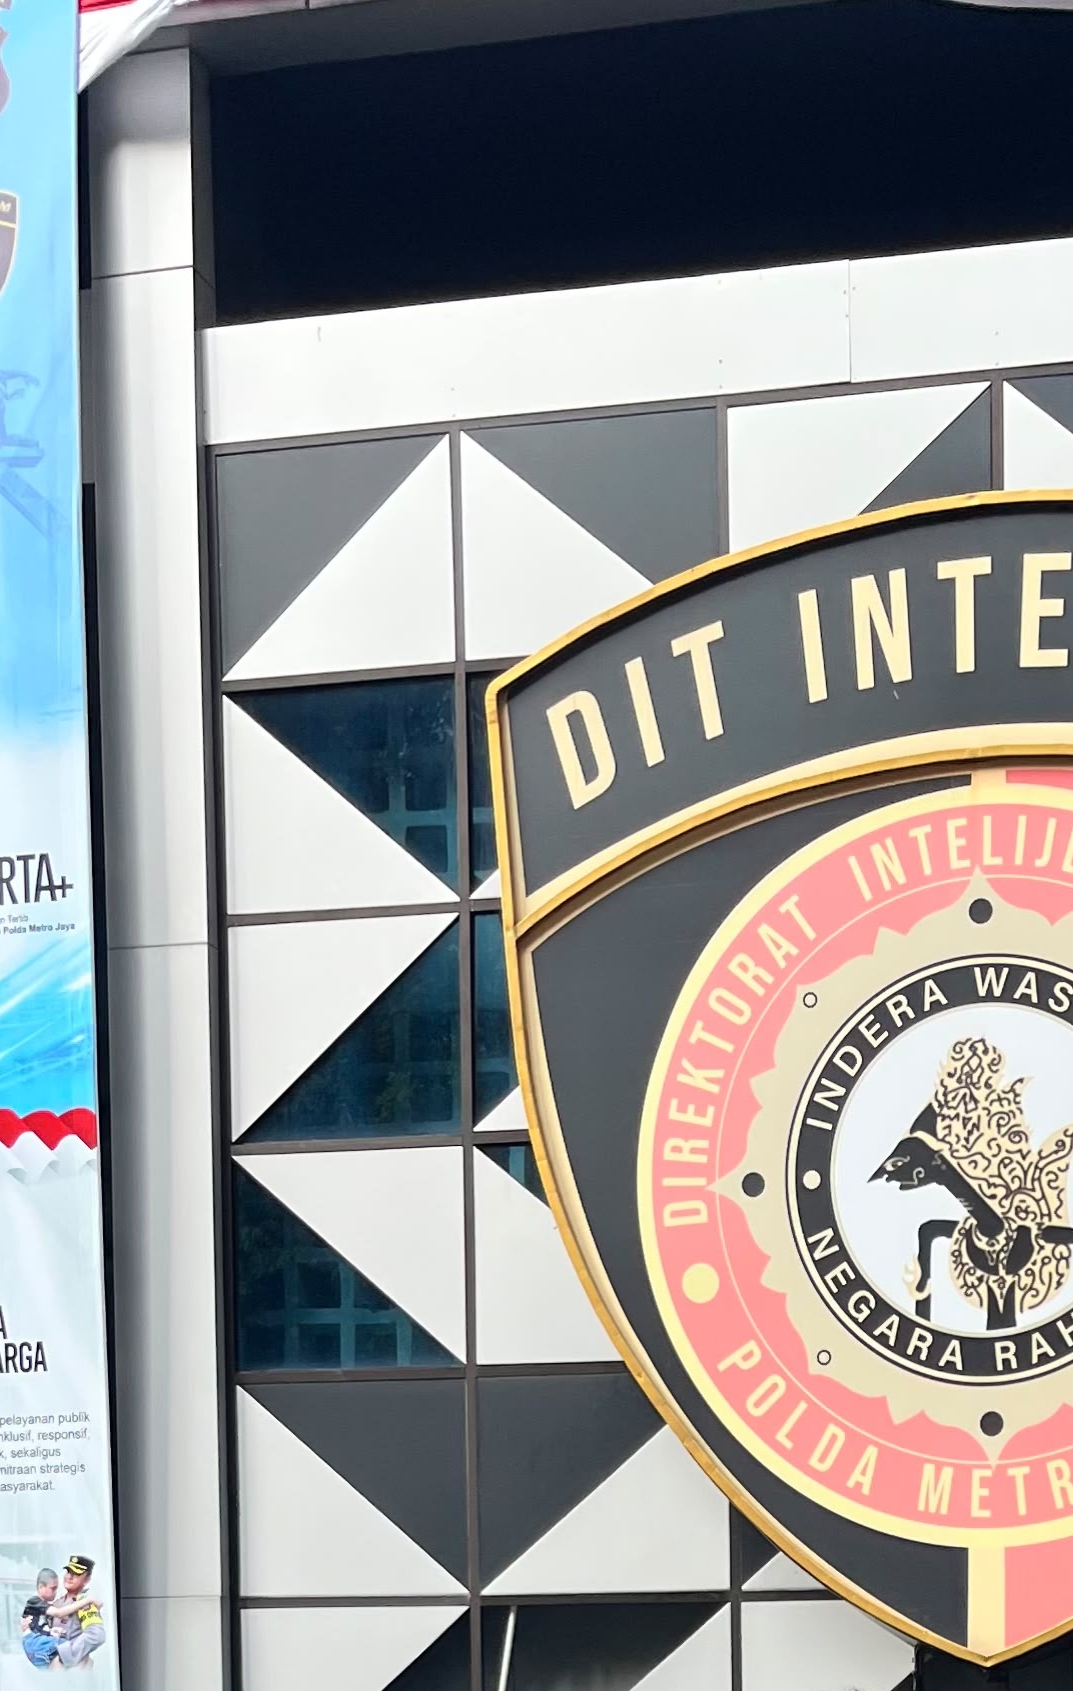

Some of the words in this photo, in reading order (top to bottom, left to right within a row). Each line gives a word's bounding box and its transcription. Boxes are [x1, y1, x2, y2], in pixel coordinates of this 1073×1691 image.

[546, 620, 729, 810] DIT
[29, 924, 53, 932] Metro
[55, 923, 75, 932] Jaya
[660, 894, 819, 1229] DIREKTORAT
[806, 976, 949, 1133] INDERA
[805, 1233, 964, 1371] NEGARA
[0, 1414, 54, 1427] pelayanan
[58, 1411, 90, 1426] publik
[11, 1447, 61, 1459] sekaligus
[40, 1462, 86, 1475] strategis
[717, 1340, 876, 1496] POLDA
